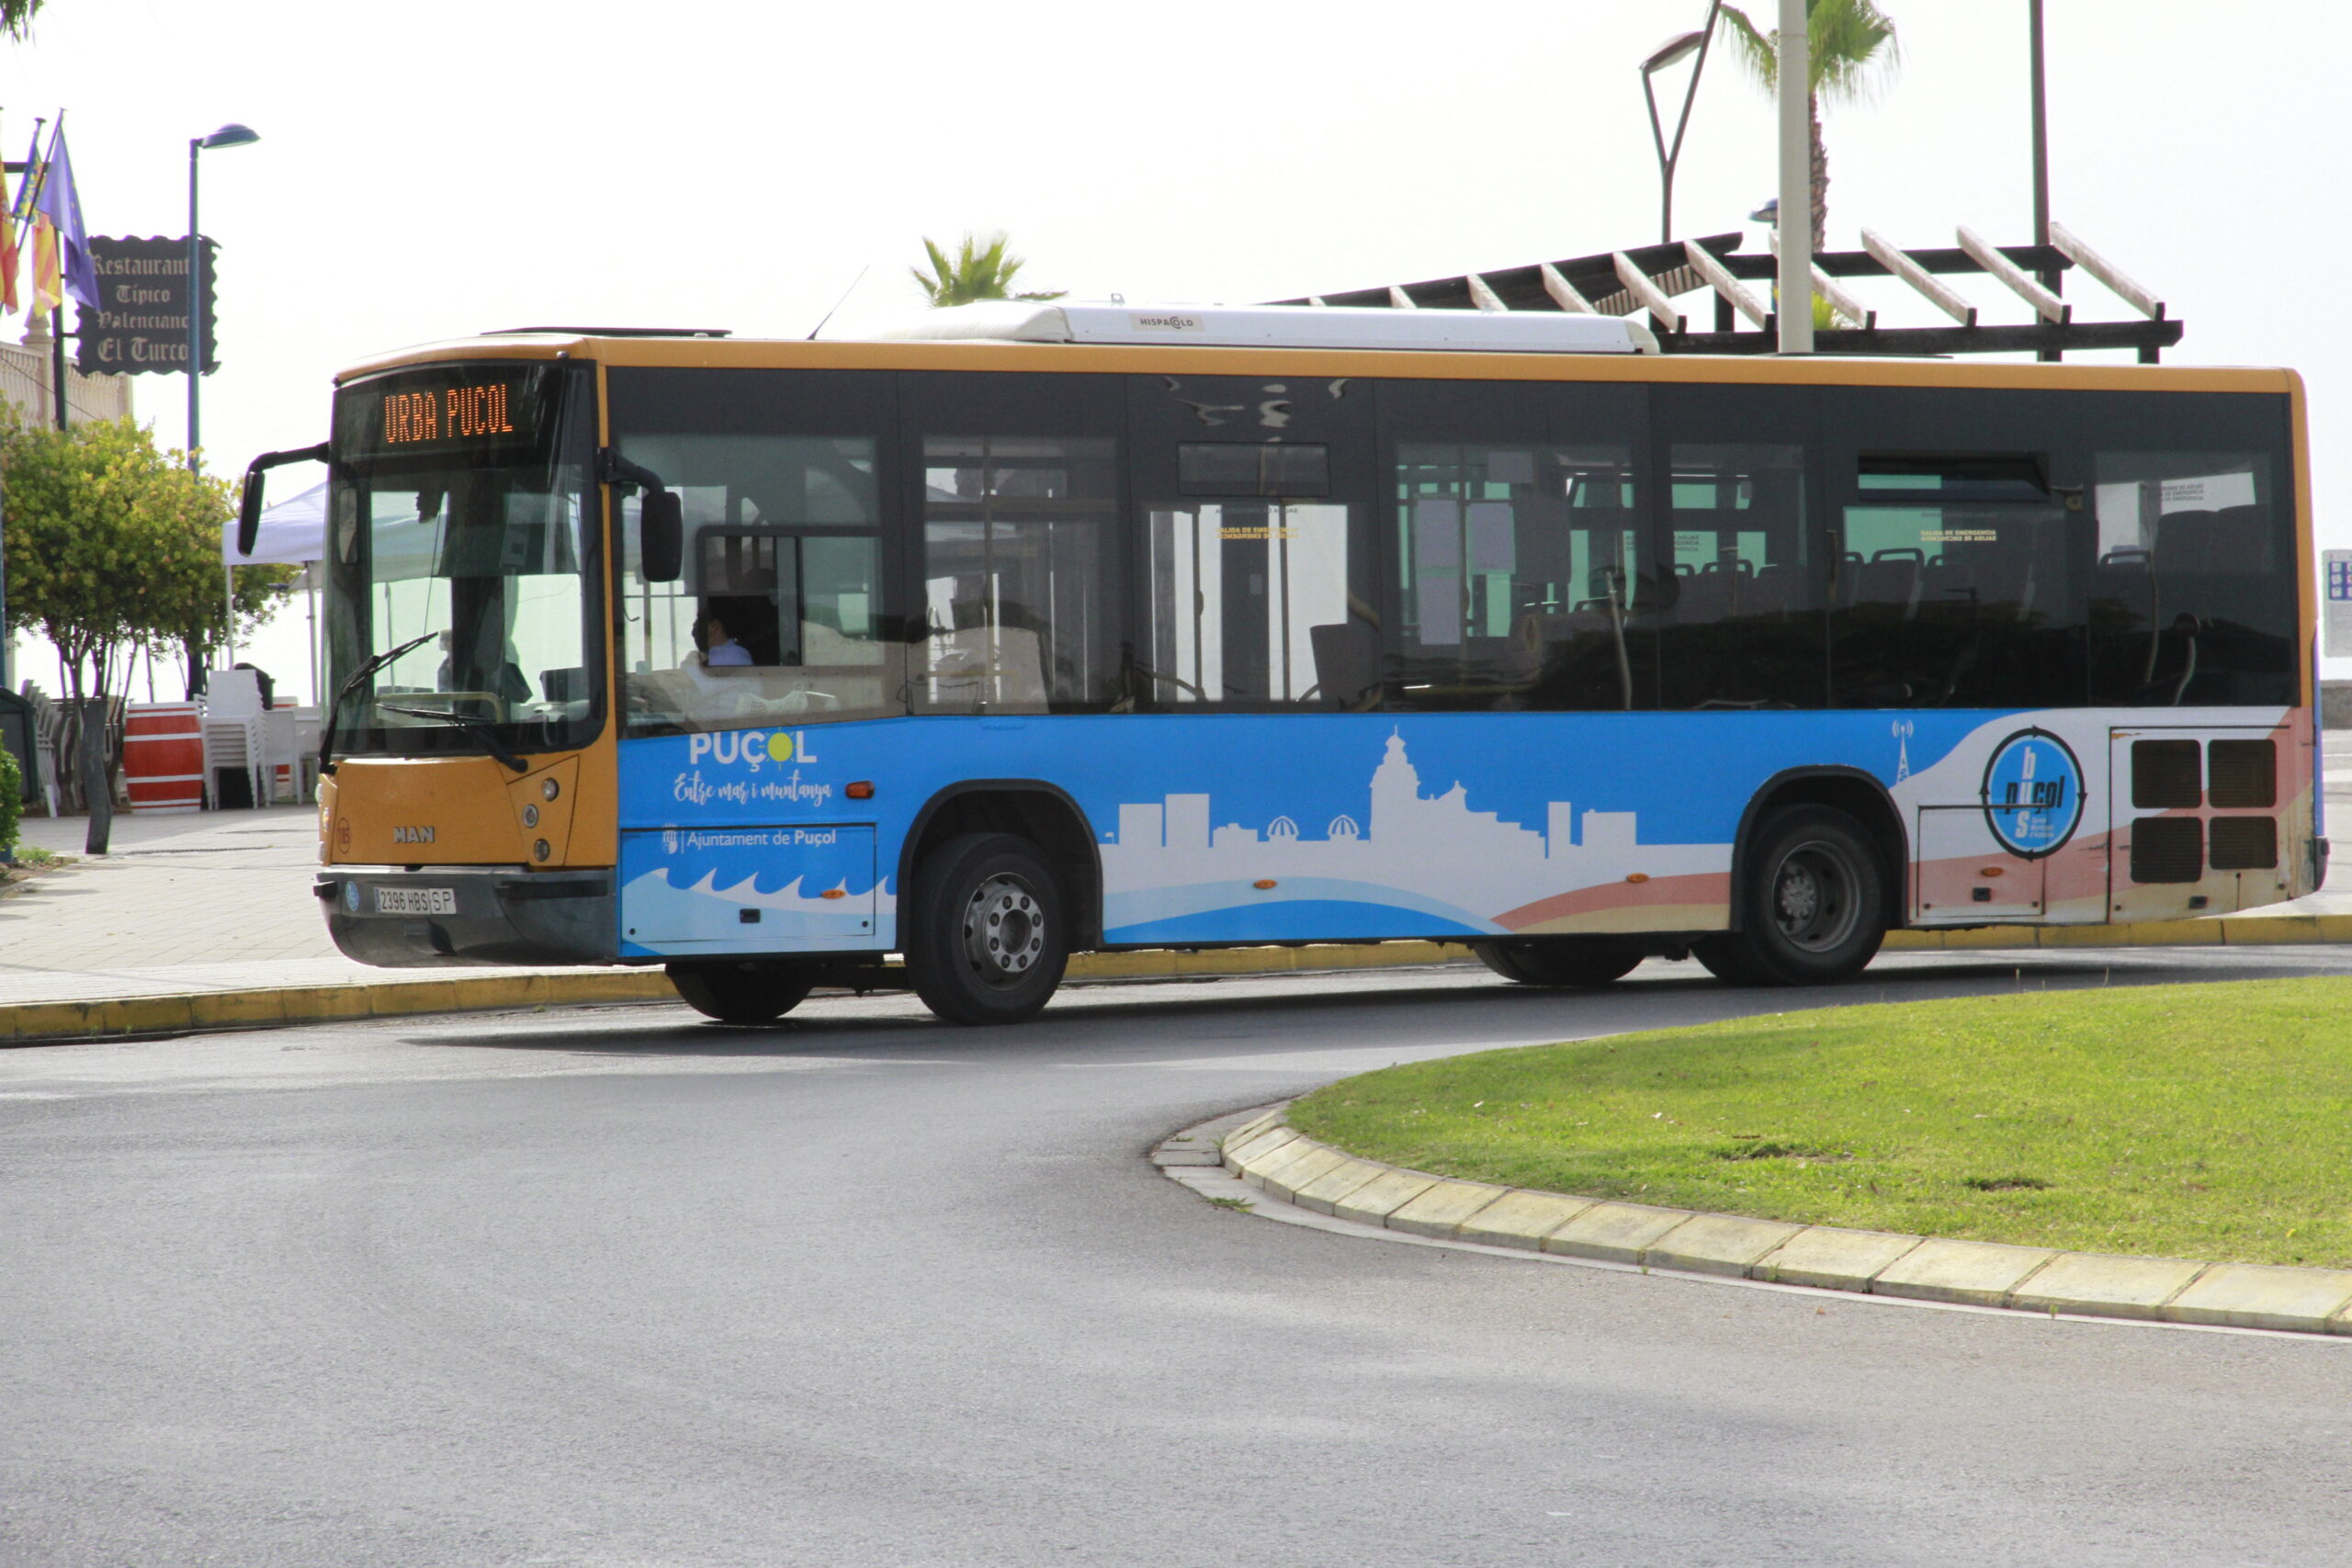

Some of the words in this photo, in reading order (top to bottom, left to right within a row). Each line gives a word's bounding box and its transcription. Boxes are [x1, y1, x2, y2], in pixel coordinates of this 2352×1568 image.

[93, 254, 189, 275] Restaurant
[116, 284, 171, 305] Típico
[1140, 316, 1194, 329] HISPACOLD
[97, 337, 123, 362] El
[130, 336, 188, 362] Turco
[385, 392, 436, 443] URBA
[447, 384, 513, 437] PUCOL
[690, 730, 818, 773] PUÇOL
[673, 770, 715, 806] Entre
[718, 782, 749, 805] mar
[752, 783, 758, 798] i
[761, 769, 832, 807] muntanya
[393, 826, 435, 843] MAN
[687, 831, 768, 851] Ajuntament
[773, 830, 790, 844] de
[795, 829, 837, 847] Puçol
[380, 891, 405, 910] 2396
[407, 892, 428, 911] HBS
[432, 891, 451, 910] SP
